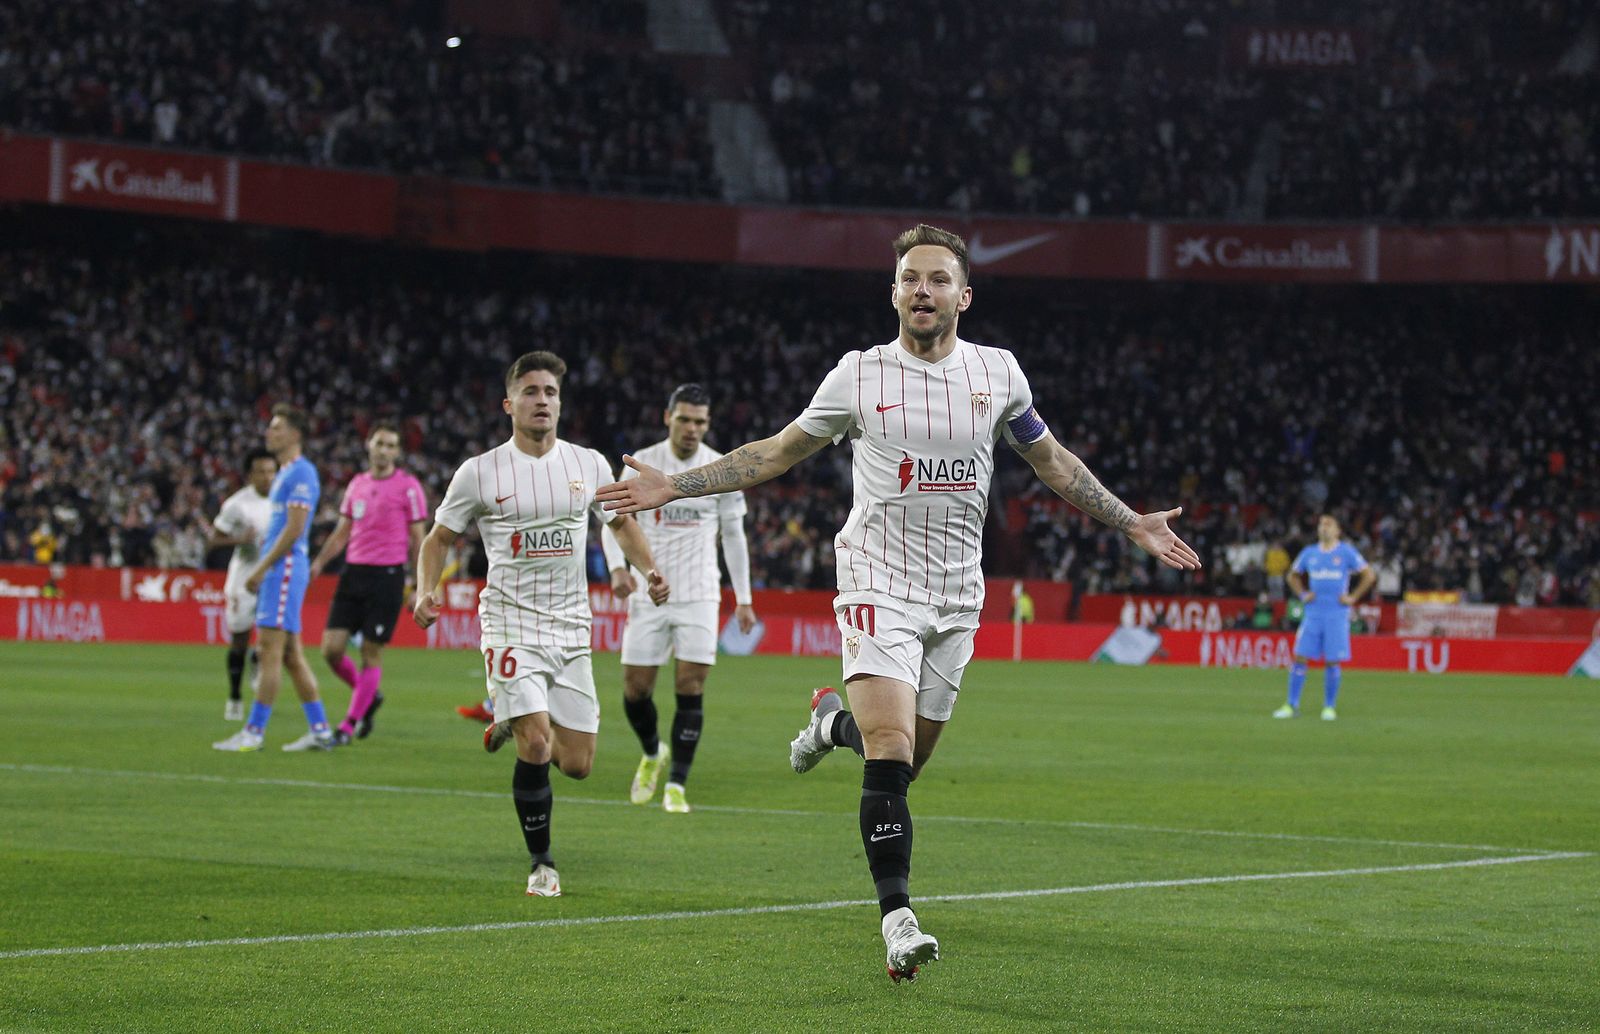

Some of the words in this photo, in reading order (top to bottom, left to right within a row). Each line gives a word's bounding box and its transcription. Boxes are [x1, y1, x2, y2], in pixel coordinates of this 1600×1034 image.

[1266, 31, 1356, 65] NAGA
[104, 160, 216, 204] CaixaBank
[1215, 237, 1351, 269] CaixaBank
[918, 458, 977, 481] NAGA
[525, 530, 573, 549] NAGA
[32, 602, 104, 641] NAGA
[1216, 635, 1294, 668] NAGA
[1402, 640, 1449, 673] TU
[875, 823, 902, 832] SFC
